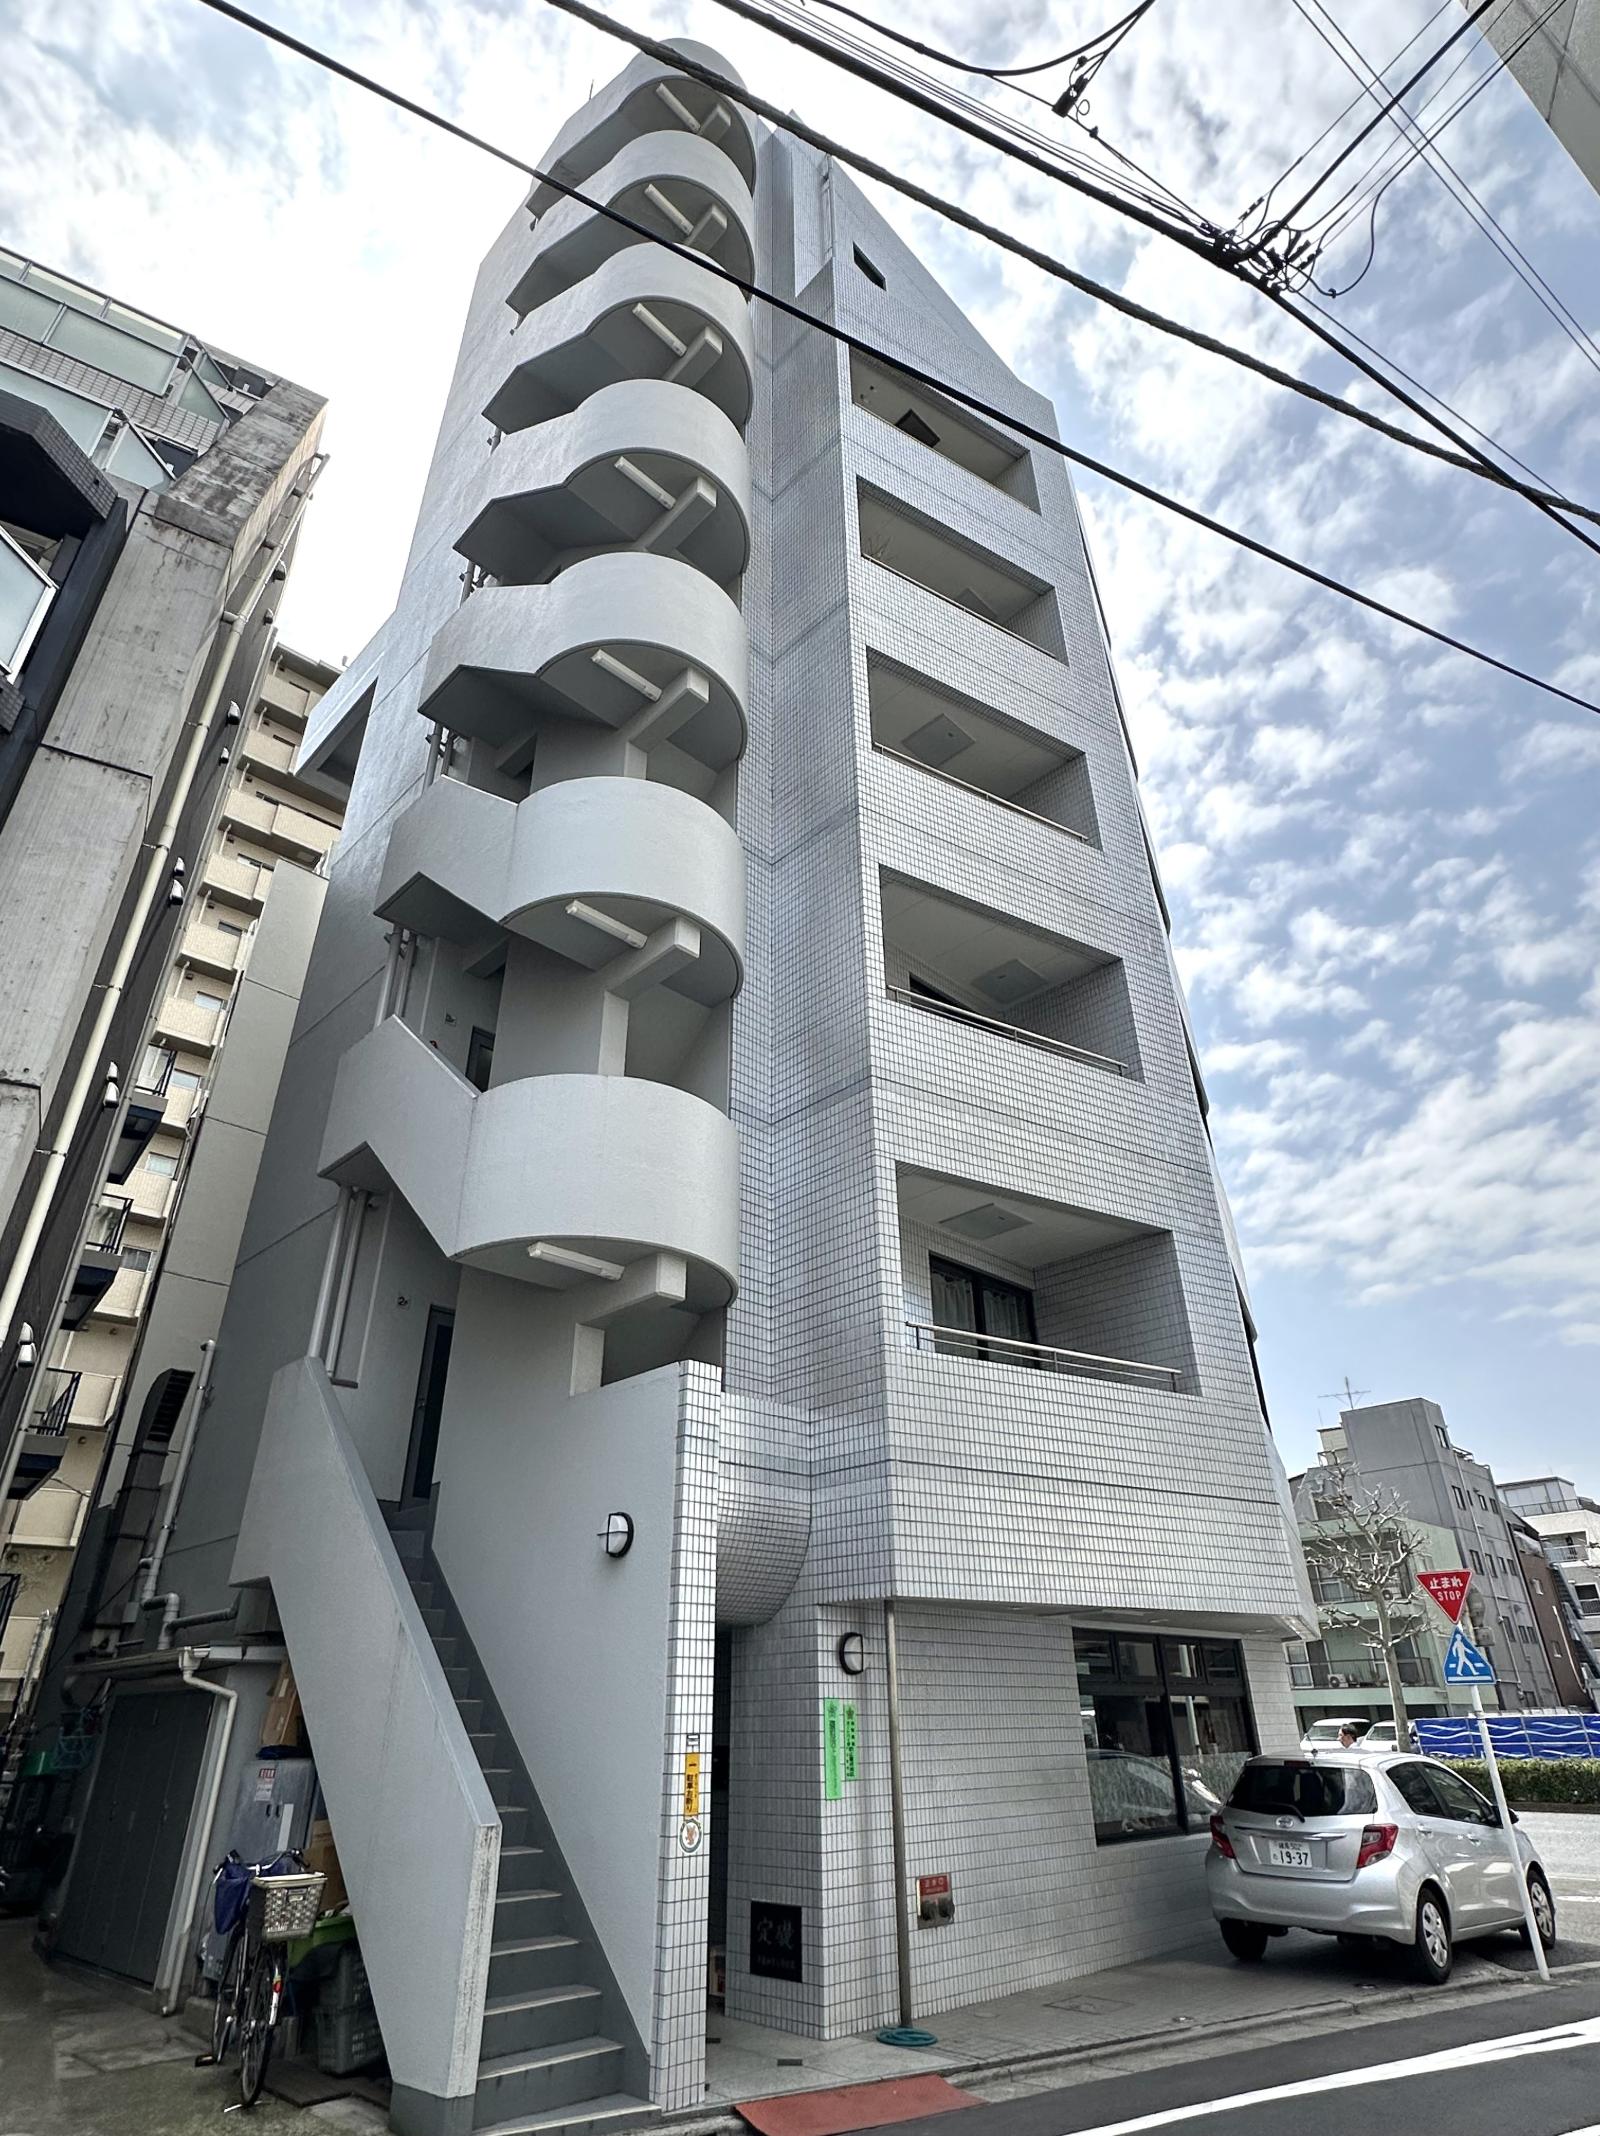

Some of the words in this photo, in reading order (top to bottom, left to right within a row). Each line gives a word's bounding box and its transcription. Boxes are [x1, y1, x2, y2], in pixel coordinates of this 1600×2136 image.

[1429, 1576, 1464, 1590] 止まれ
[1437, 1590, 1462, 1601] STOP
